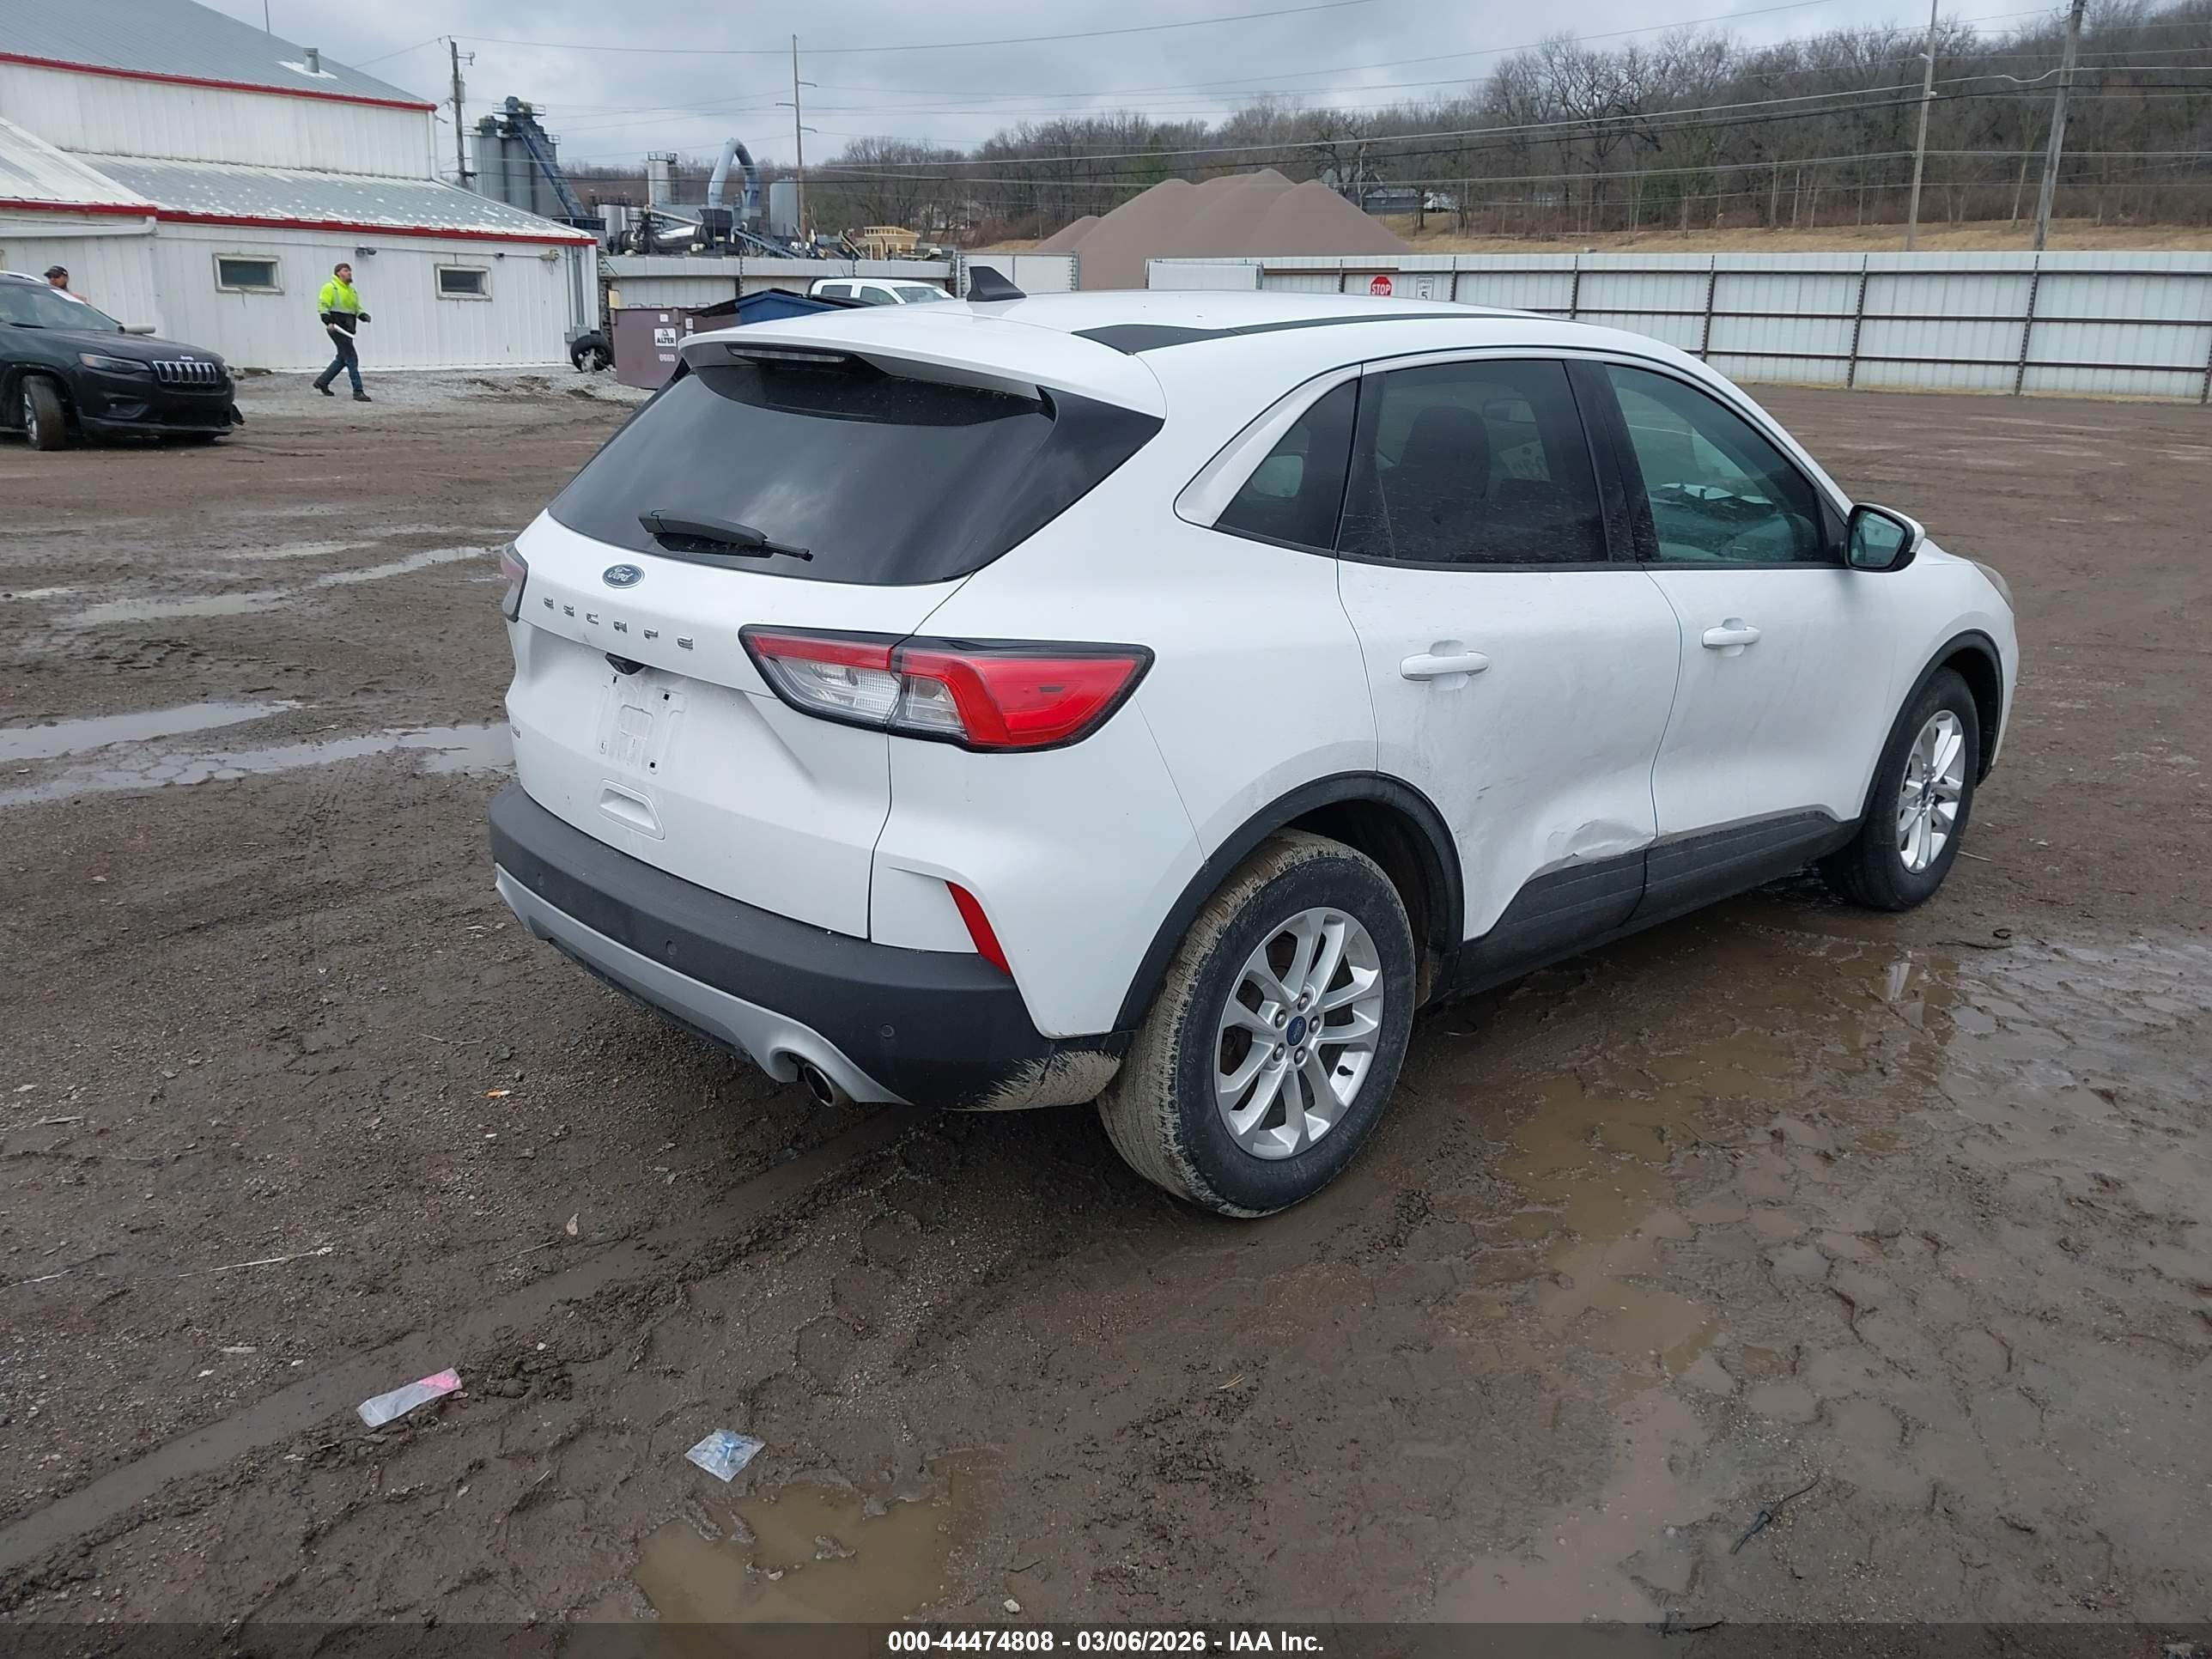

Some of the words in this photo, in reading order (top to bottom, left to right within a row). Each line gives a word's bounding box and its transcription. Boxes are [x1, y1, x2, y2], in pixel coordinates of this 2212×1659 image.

[1371, 283, 1391, 295] STOP
[608, 567, 634, 581] Ford
[544, 597, 694, 650] ESCAPE
